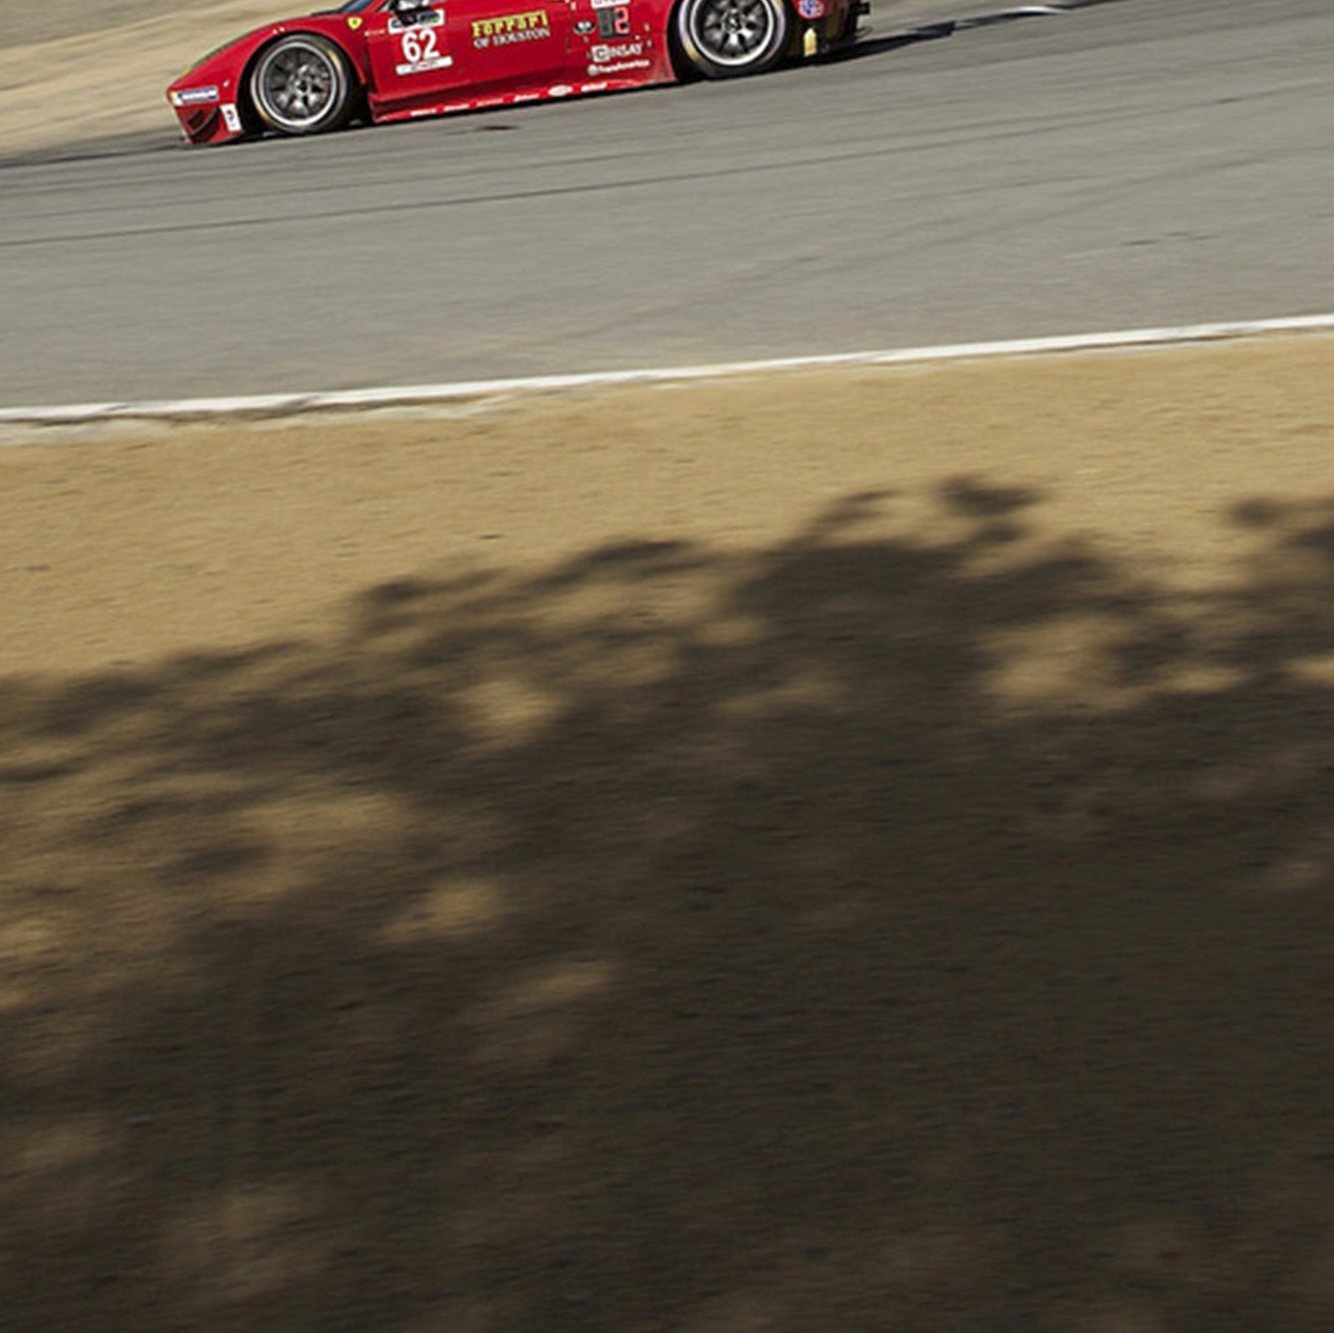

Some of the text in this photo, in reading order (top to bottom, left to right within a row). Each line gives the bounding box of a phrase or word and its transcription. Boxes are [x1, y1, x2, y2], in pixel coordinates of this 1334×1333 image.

[402, 27, 441, 64] 62
[473, 28, 550, 50] OF HOUSTON
